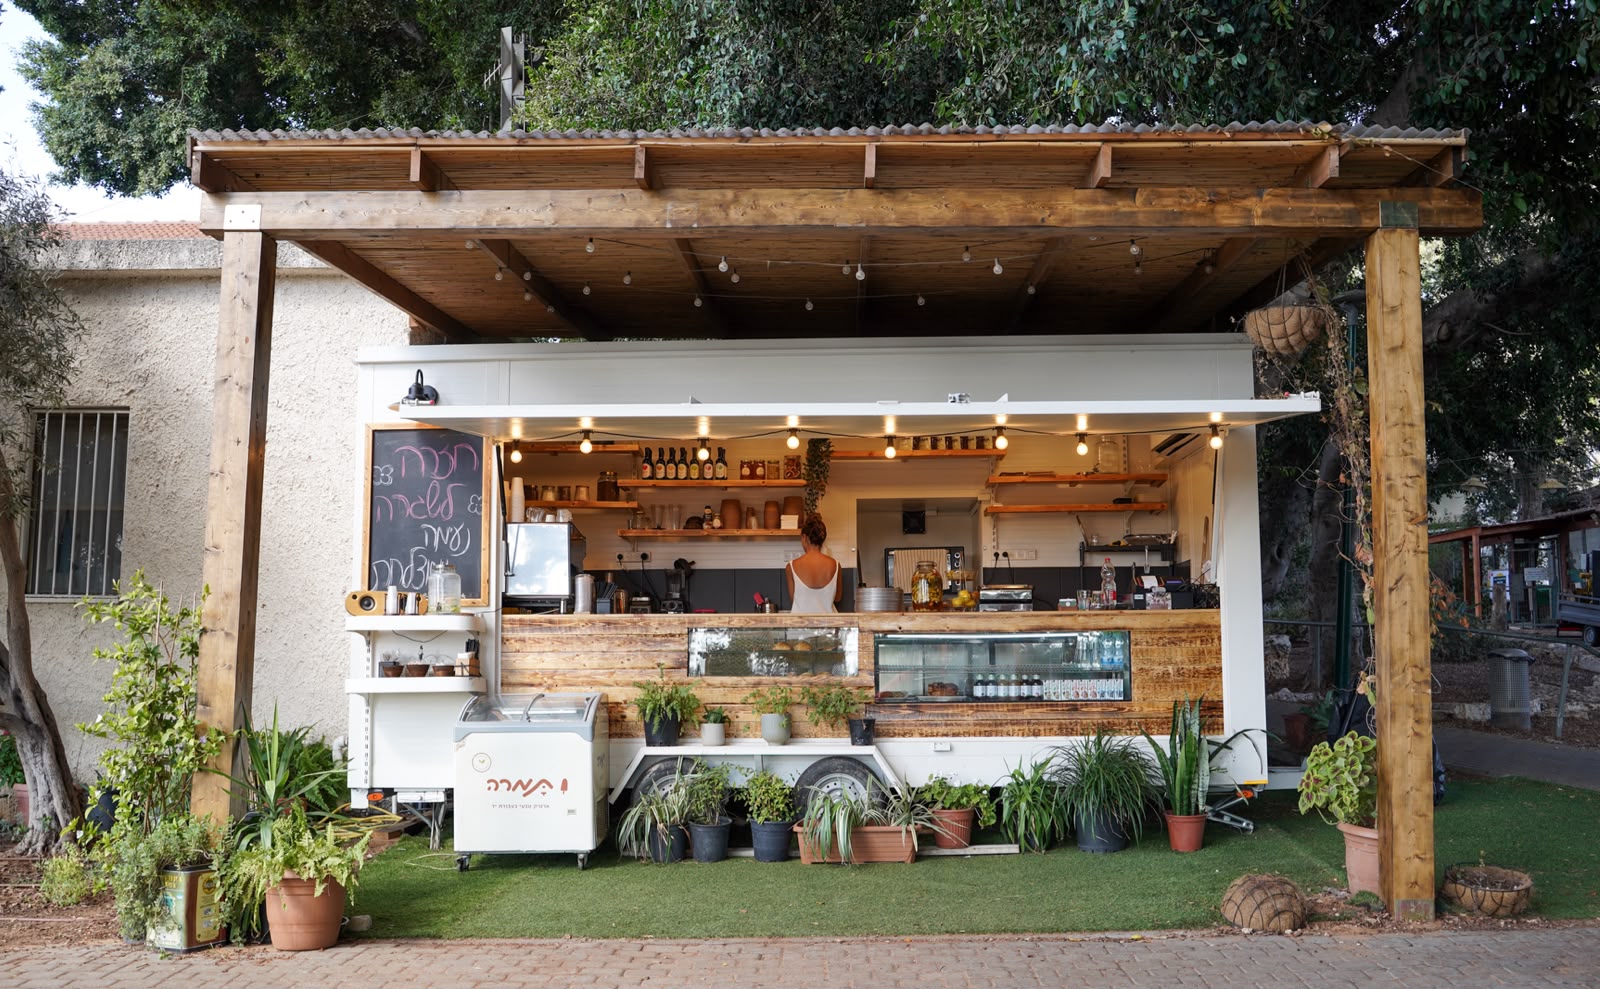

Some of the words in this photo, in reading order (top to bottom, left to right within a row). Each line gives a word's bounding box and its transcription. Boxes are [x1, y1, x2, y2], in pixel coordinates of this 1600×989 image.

[392, 443, 479, 480] חזרה
[375, 480, 467, 523] לשגרה
[420, 521, 471, 557] נעימה
